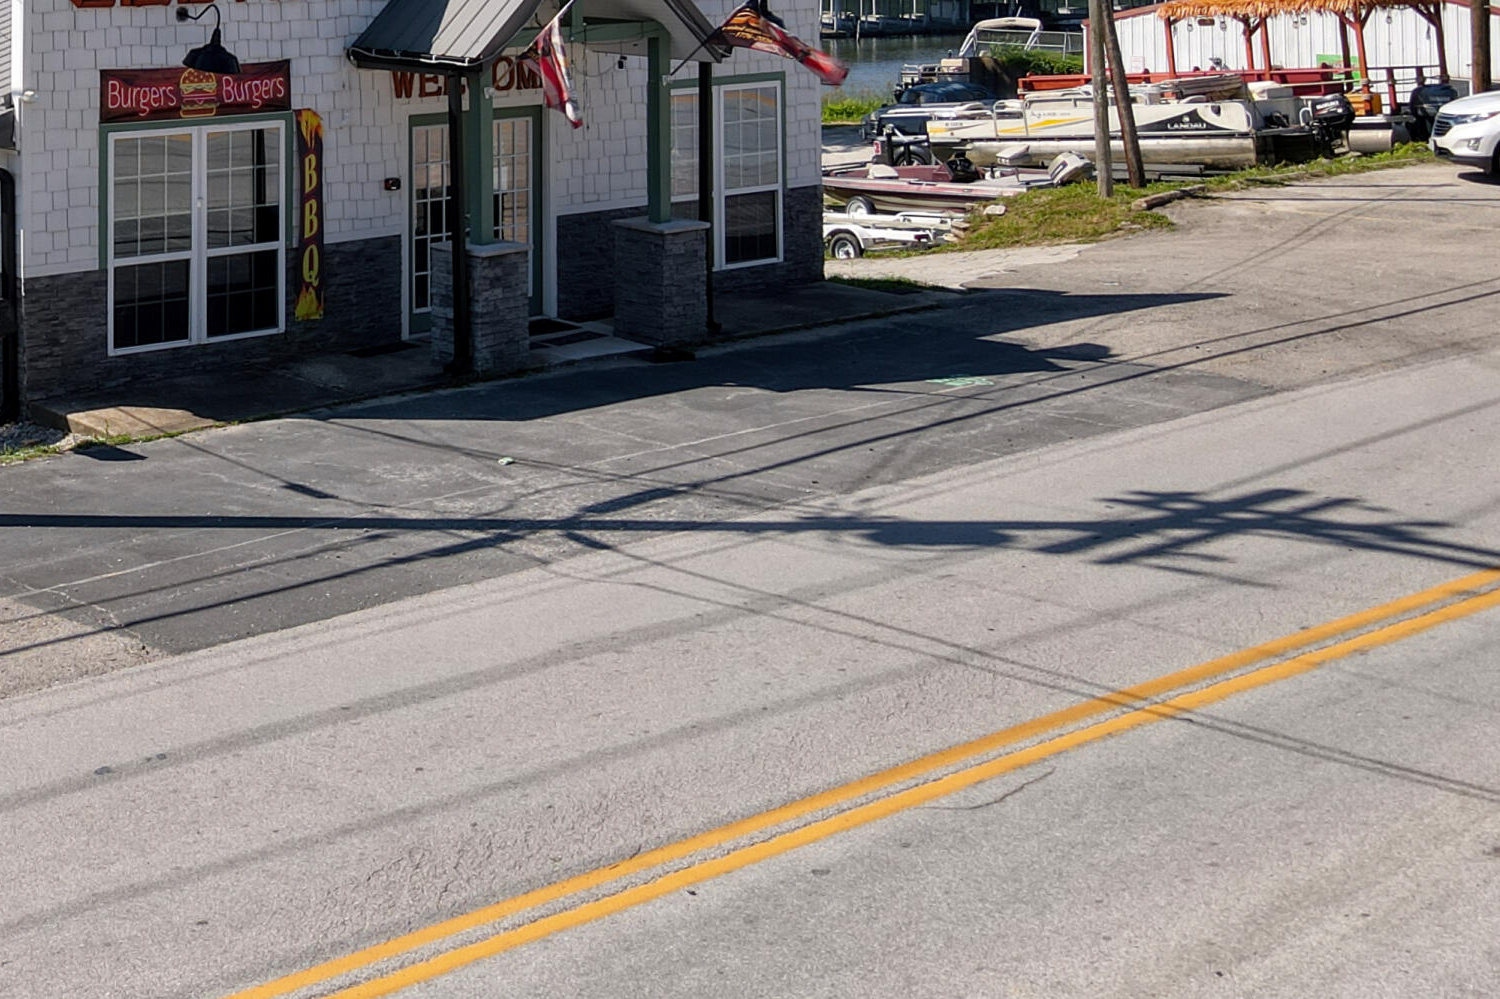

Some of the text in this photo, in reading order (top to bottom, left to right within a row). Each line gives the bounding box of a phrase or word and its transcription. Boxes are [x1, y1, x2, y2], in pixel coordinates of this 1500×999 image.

[108, 76, 285, 117] Burgers Burgers
[392, 56, 543, 98] WEOM
[303, 153, 320, 288] BBQ
